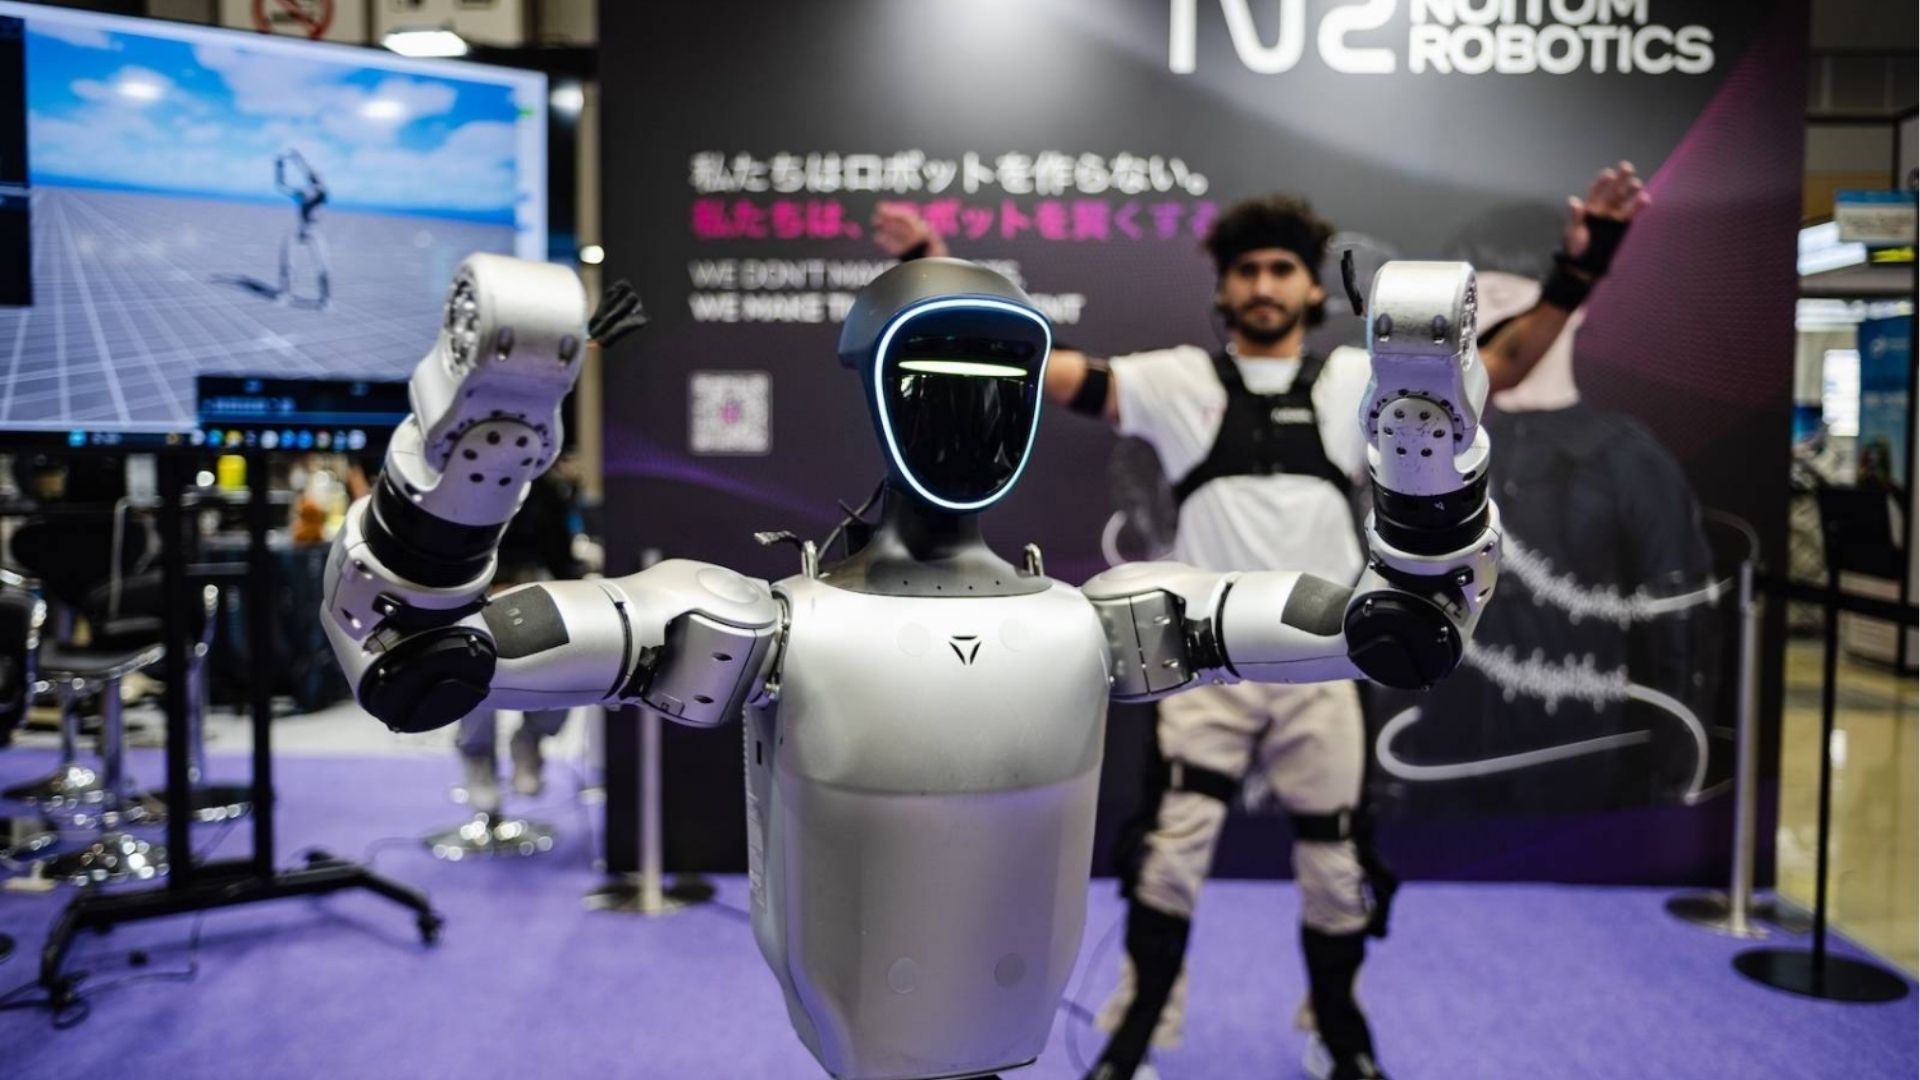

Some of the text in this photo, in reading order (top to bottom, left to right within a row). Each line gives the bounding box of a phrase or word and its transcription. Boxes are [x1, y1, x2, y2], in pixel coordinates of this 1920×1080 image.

[1409, 23, 1715, 74] ROBOTICS
[690, 150, 1208, 195] 私たちはロボットを作らない。
[688, 259, 738, 290] WE
[688, 291, 740, 323] WE
